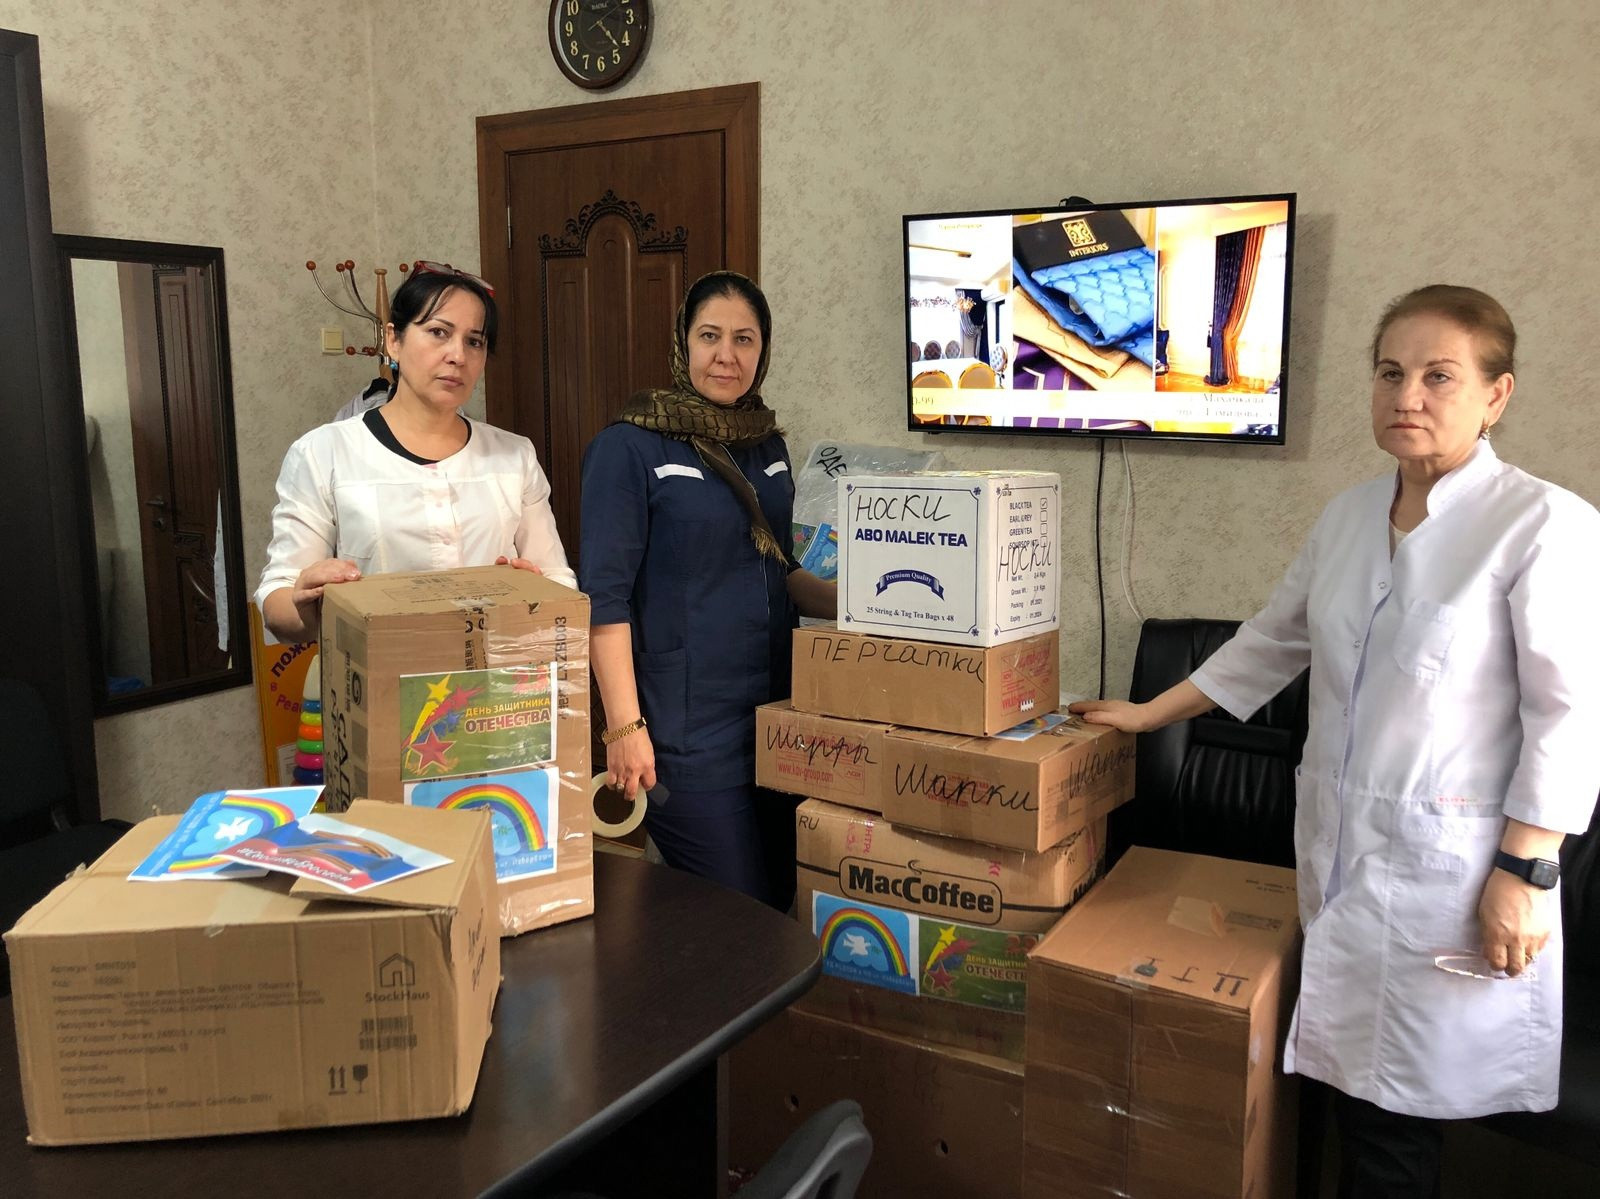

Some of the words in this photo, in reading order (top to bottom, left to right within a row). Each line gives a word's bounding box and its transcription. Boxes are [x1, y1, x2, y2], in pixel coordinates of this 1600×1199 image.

[566, 0, 579, 16] 10
[626, 8, 634, 25] 3
[565, 21, 574, 37] 9
[621, 30, 631, 47] 4
[570, 40, 579, 56] 8
[582, 54, 590, 70] 7
[596, 56, 605, 72] 6
[612, 49, 621, 65] 5
[1068, 242, 1109, 258] INTERIORS
[855, 494, 951, 521] НОСКИ
[1009, 502, 1023, 510] BLACK
[1009, 515, 1020, 523] EARL
[1021, 514, 1032, 522] GREY
[855, 528, 883, 542] ABO
[885, 529, 936, 545] MALEK
[938, 532, 968, 547] TEA
[1009, 528, 1024, 536] GREEN
[1024, 527, 1032, 535] TEA
[998, 540, 1052, 582] НОСКИ
[886, 572, 911, 581] Premium
[911, 572, 932, 584] Quality
[875, 607, 893, 616] String
[901, 610, 912, 618] Tag
[925, 612, 940, 621] Bags
[276, 694, 301, 713] Реа
[465, 706, 492, 718] ДЕНЬ
[493, 697, 551, 713] ЗАЩИТНИКА
[465, 709, 551, 733] ОТЕЧЕСТВА
[896, 763, 1039, 812] Шапки
[799, 815, 819, 831] RU
[848, 864, 995, 914] MacCoffee
[365, 990, 431, 1003] StockHaus
